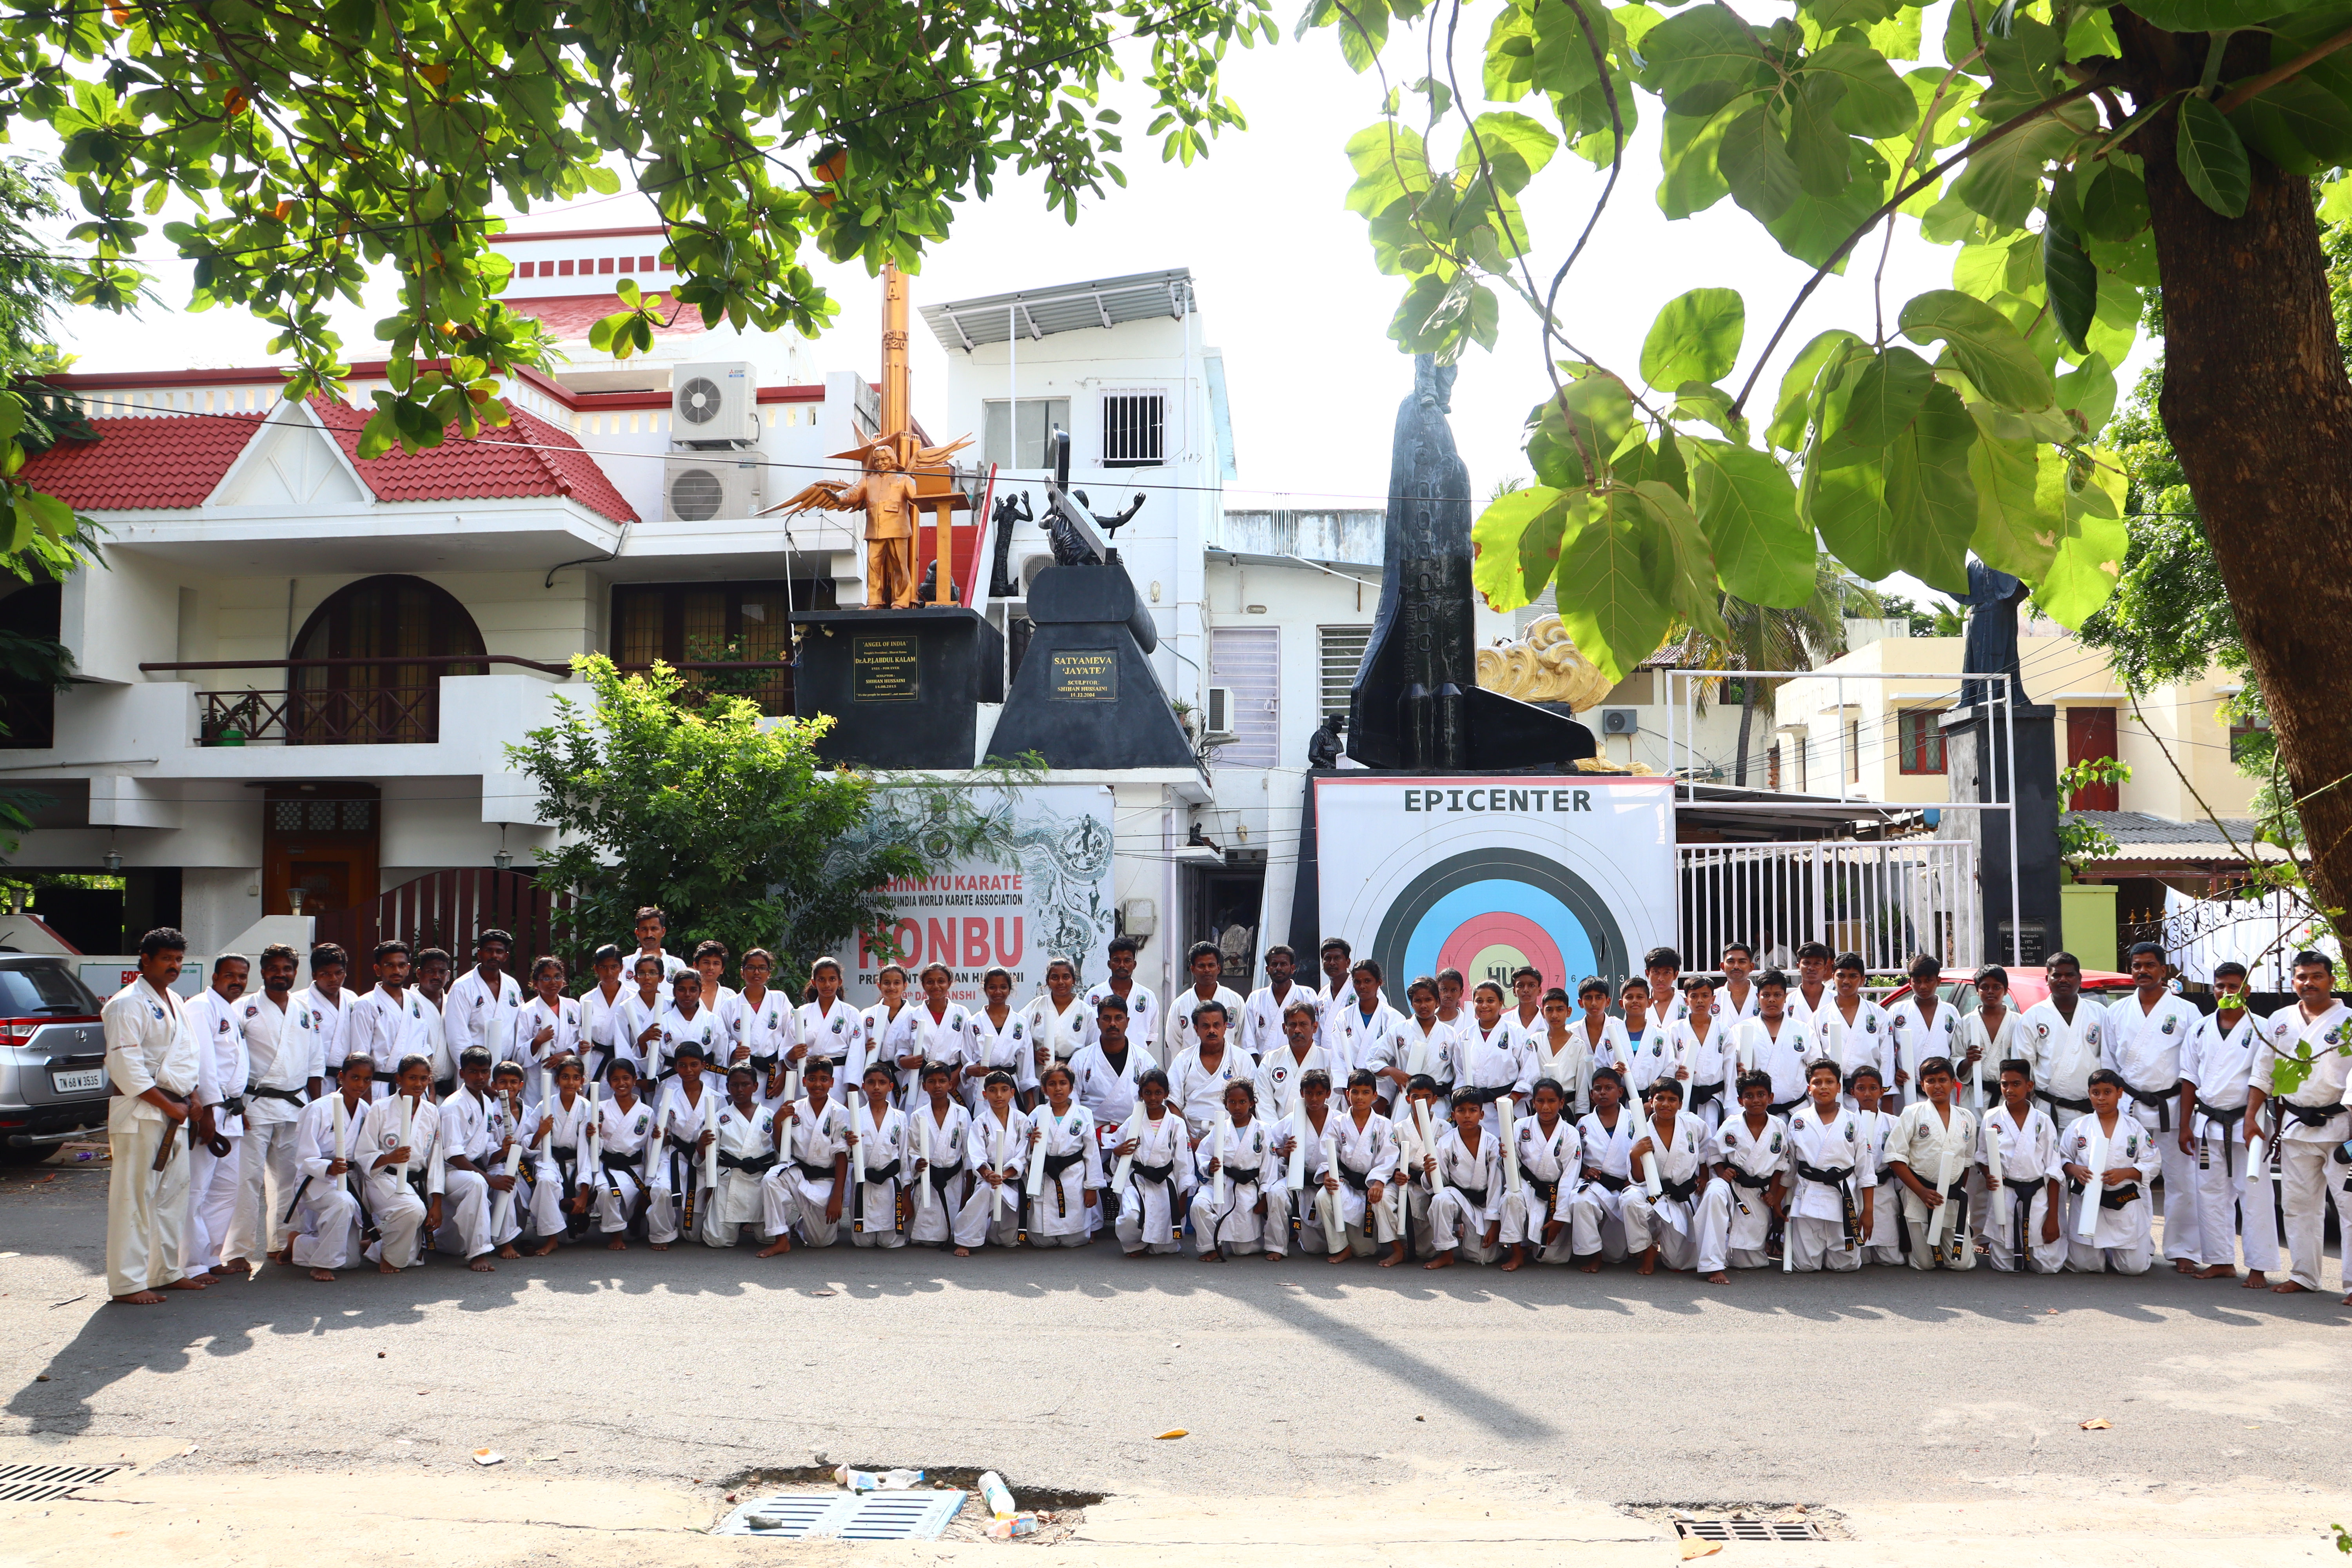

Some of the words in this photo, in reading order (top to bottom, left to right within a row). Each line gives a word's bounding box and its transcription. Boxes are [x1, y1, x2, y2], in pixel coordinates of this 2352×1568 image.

[1405, 789, 1592, 812] EPICENTER
[955, 875, 1022, 891] KARATE
[897, 895, 916, 907] INDIA
[918, 894, 943, 907] WORLD
[945, 894, 973, 906] KARATE
[975, 894, 1023, 906] ASSOCIATION
[858, 916, 1023, 969] HONBU
[902, 991, 913, 1001] 9th
[59, 1078, 67, 1089] TN
[68, 1078, 76, 1088] 68
[83, 1075, 98, 1086] 3535
[1845, 1198, 1864, 1244] 一心流空手道
